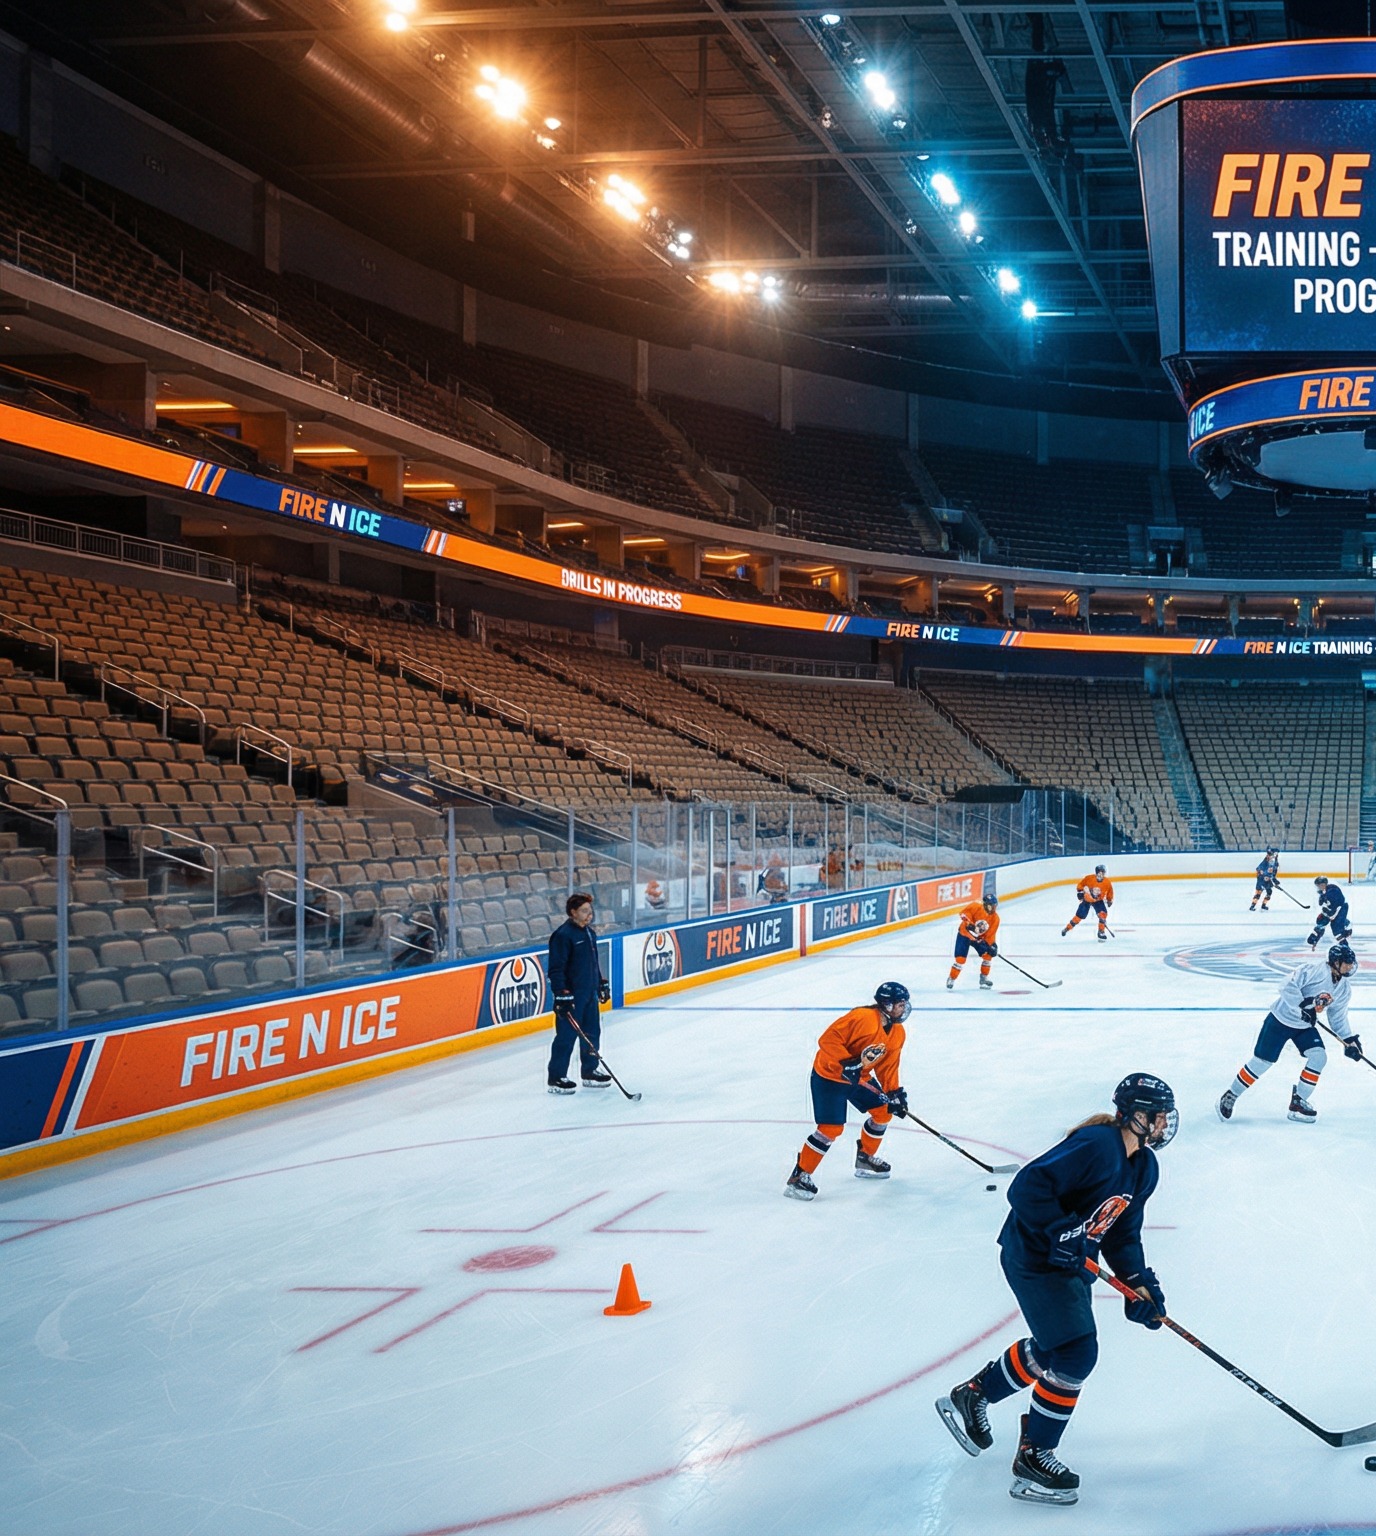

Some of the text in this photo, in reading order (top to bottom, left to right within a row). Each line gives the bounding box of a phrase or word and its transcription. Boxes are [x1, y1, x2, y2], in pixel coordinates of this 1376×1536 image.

[1212, 154, 1371, 217] FIRE
[1212, 231, 1360, 267] TRAINING
[1299, 376, 1374, 410] FIRE
[279, 488, 381, 537] FIRE N ICE
[561, 568, 682, 610] DRILLS IN PROGRESS
[886, 622, 959, 641] FIRE N ICE
[1244, 641, 1274, 654] FIRE
[1275, 641, 1287, 654] N
[1288, 641, 1310, 654] ICE
[1312, 641, 1373, 654] TRAINING
[706, 918, 782, 960] FIRE N ICE
[180, 995, 401, 1088] FIRE N ICE
